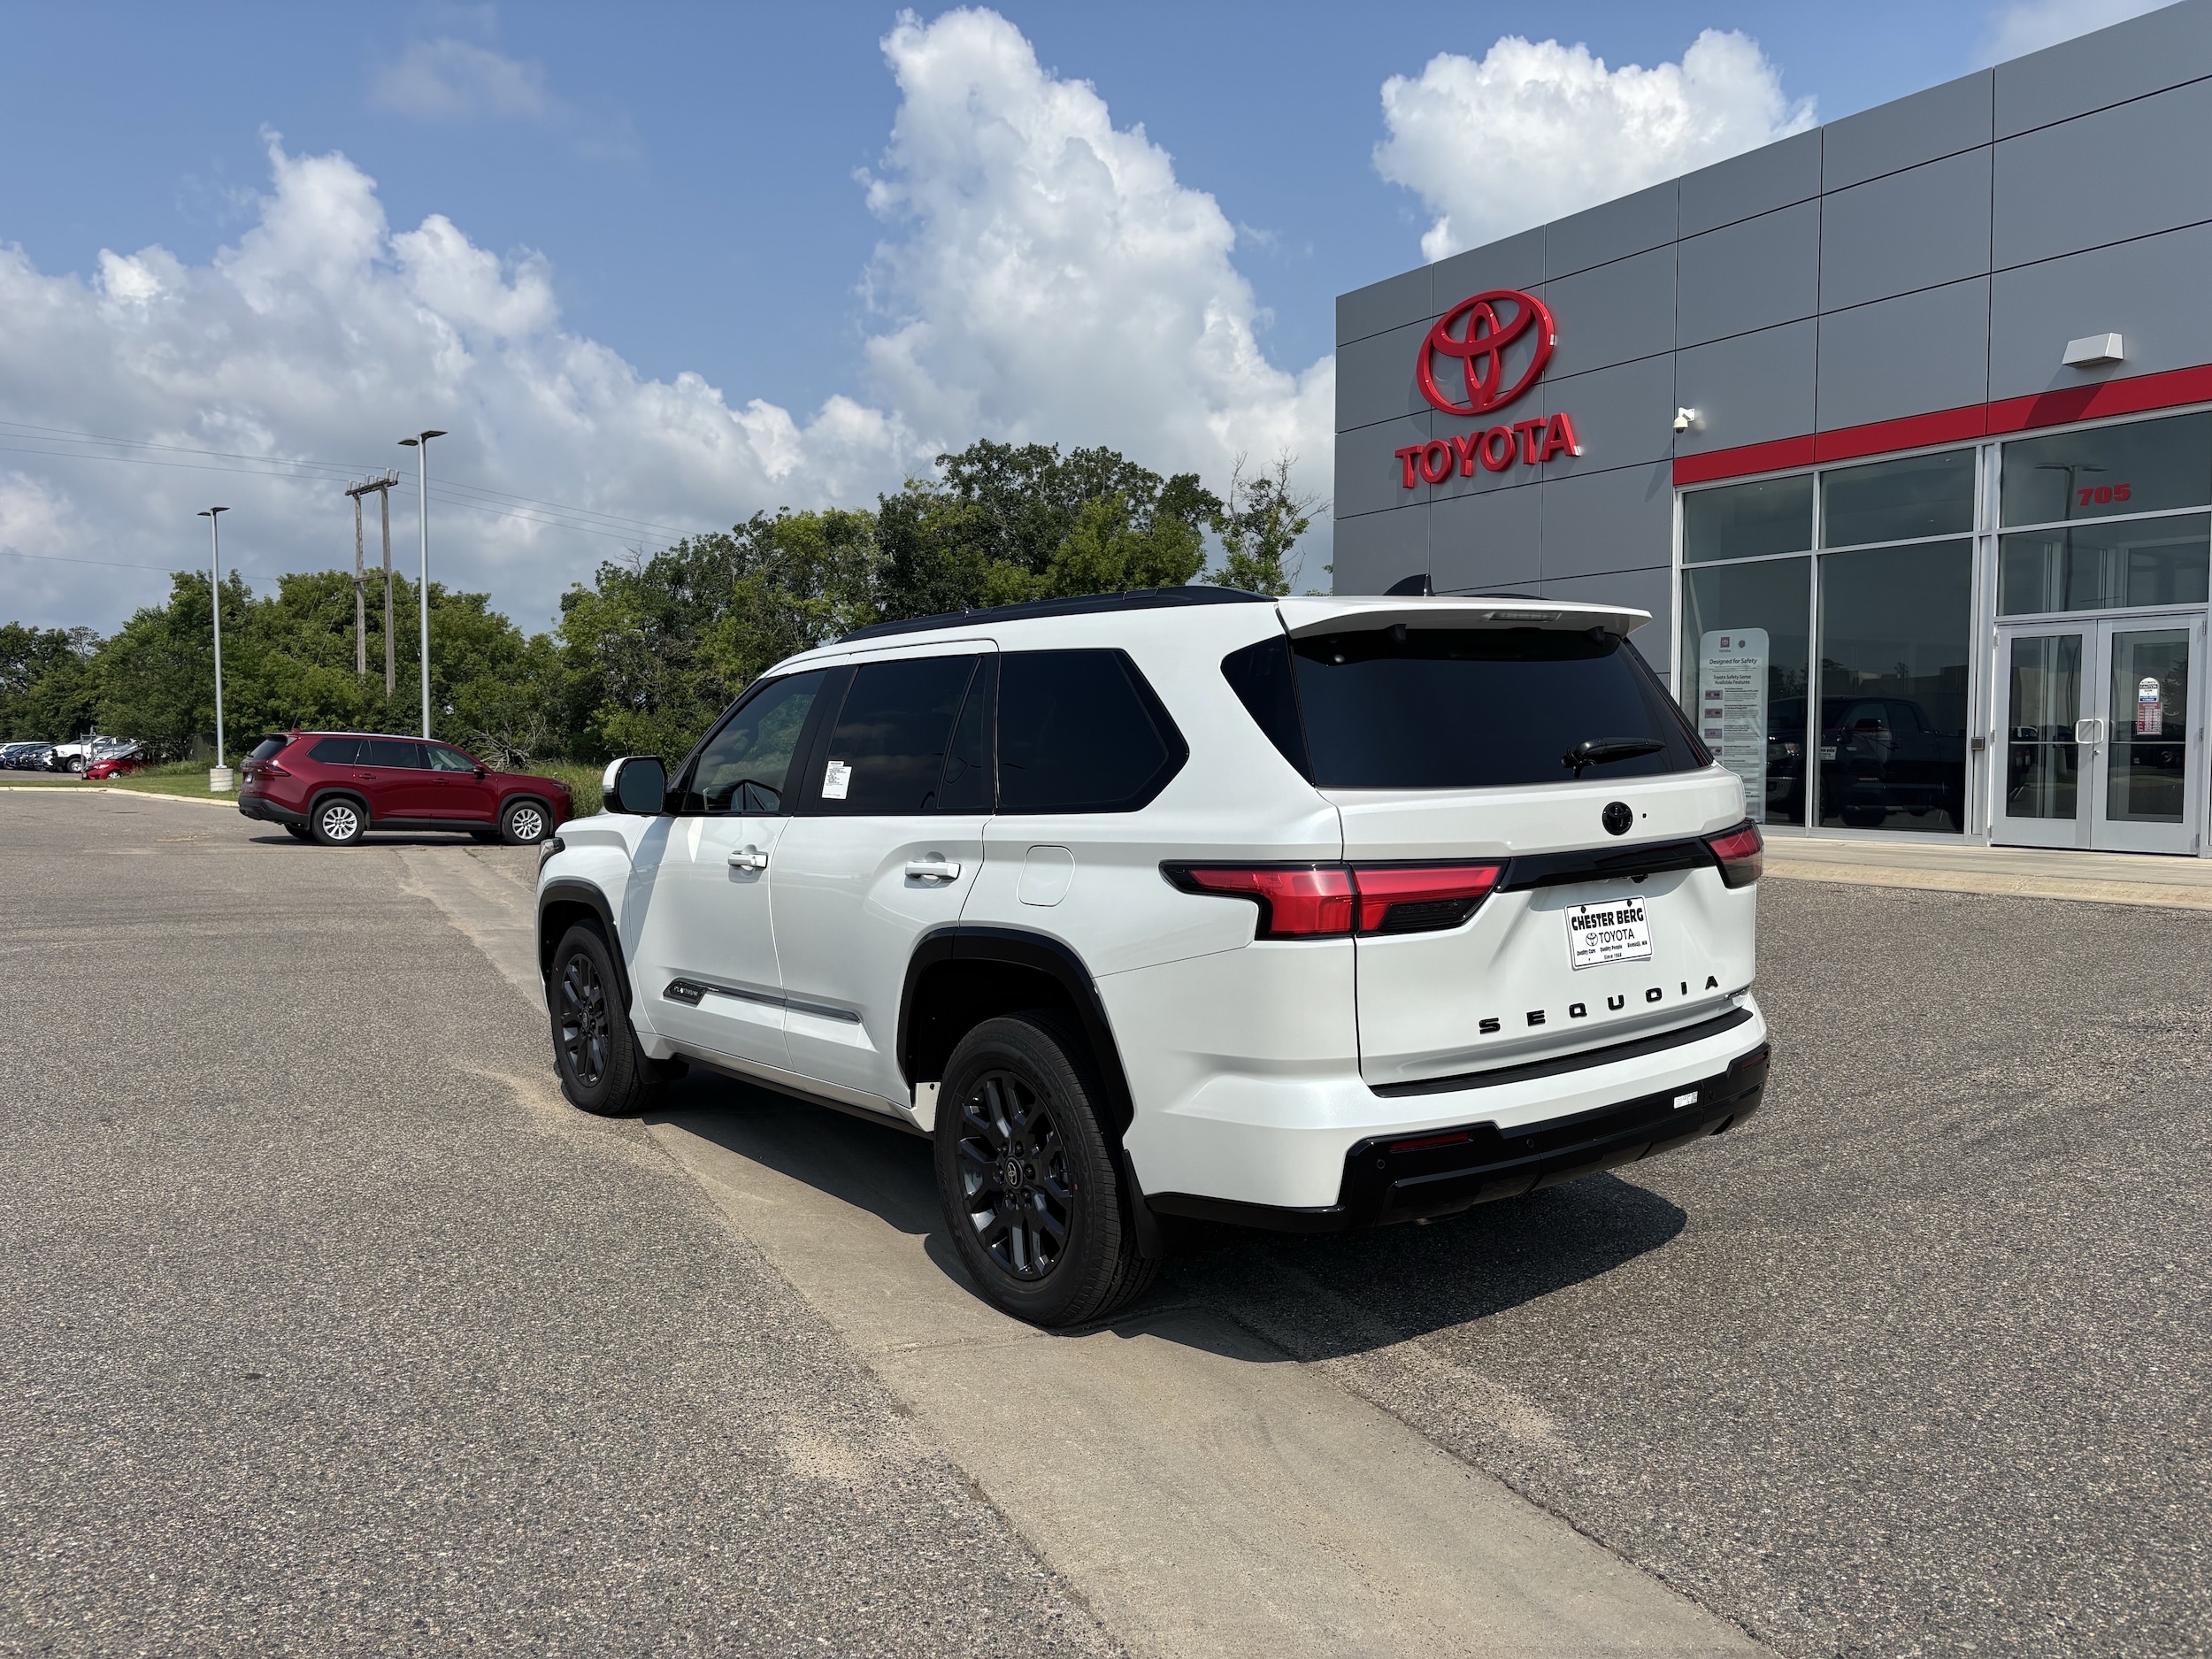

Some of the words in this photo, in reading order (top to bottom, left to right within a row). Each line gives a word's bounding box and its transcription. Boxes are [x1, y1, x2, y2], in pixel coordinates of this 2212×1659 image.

[1394, 412, 1582, 489] TOYOTA
[2077, 483, 2131, 507] 705
[1571, 911, 1615, 931] CHESTER
[1617, 908, 1644, 925] BERG
[1599, 928, 1635, 943] TOYOTA
[1479, 975, 1718, 1034] SEQUOIA
